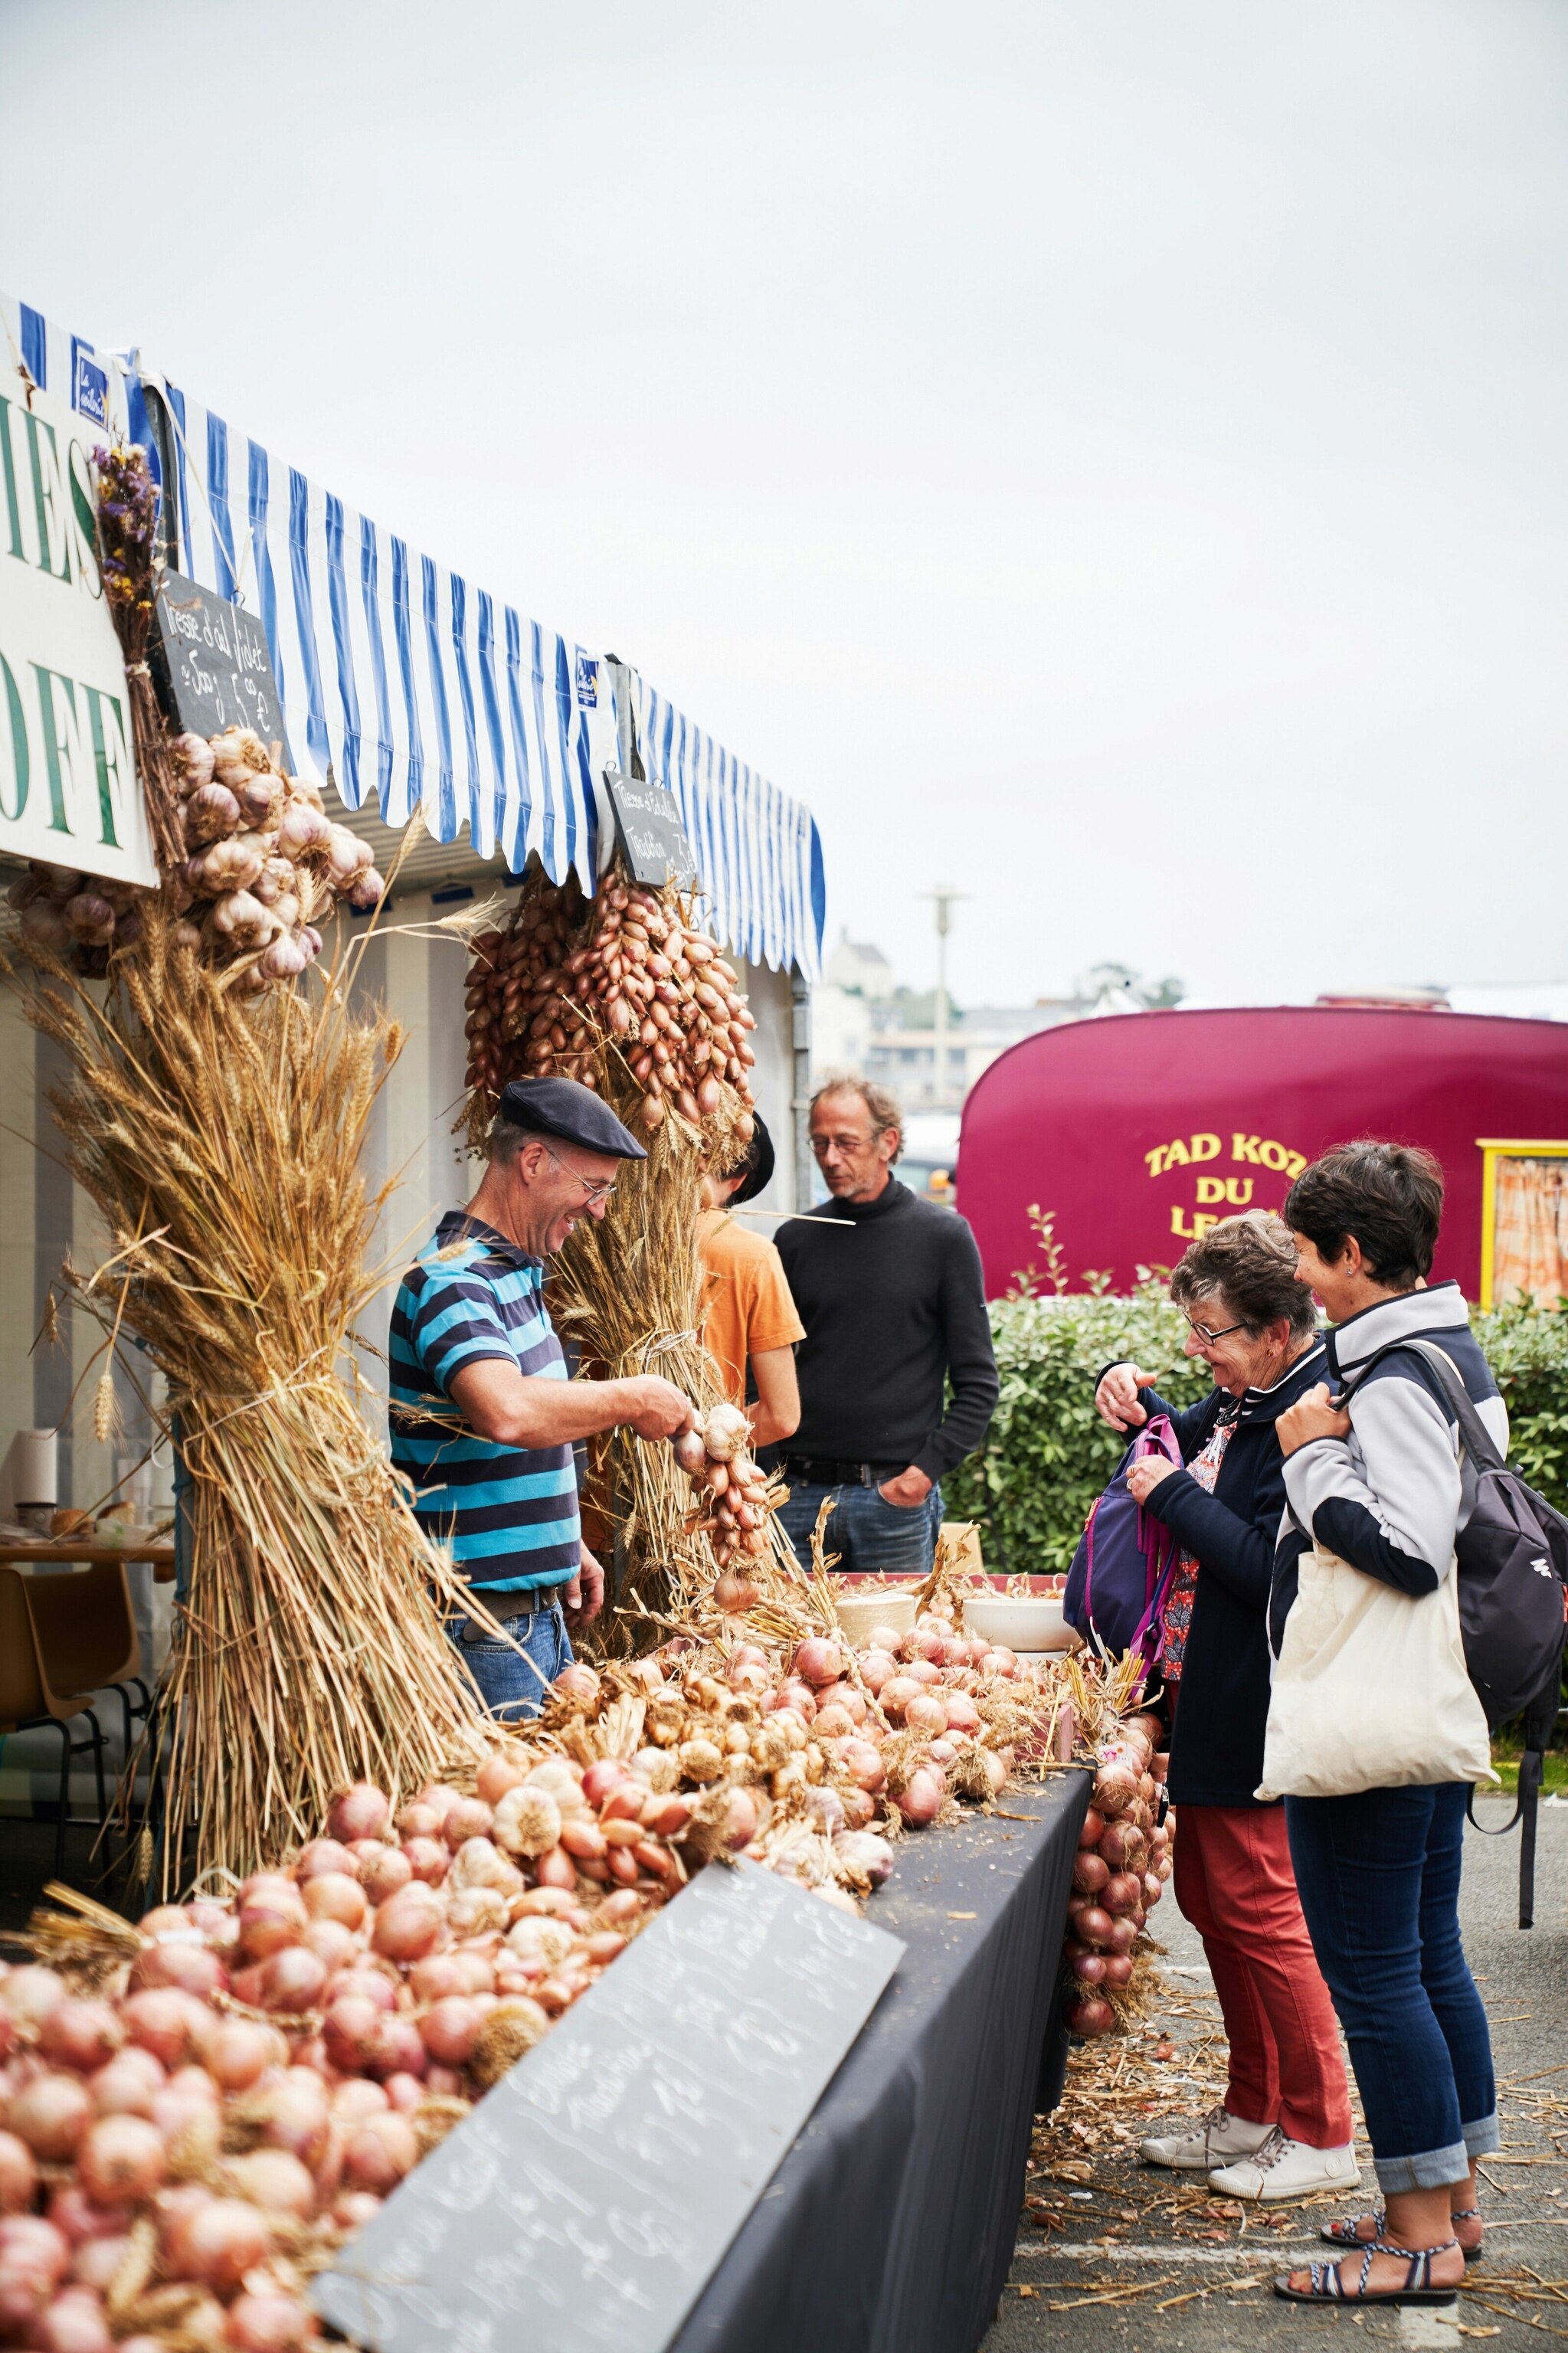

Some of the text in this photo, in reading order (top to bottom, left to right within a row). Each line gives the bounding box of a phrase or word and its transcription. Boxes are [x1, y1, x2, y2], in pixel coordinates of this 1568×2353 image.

[1144, 1132, 1308, 1180] TAD KOZ
[1196, 1176, 1255, 1205] DU
